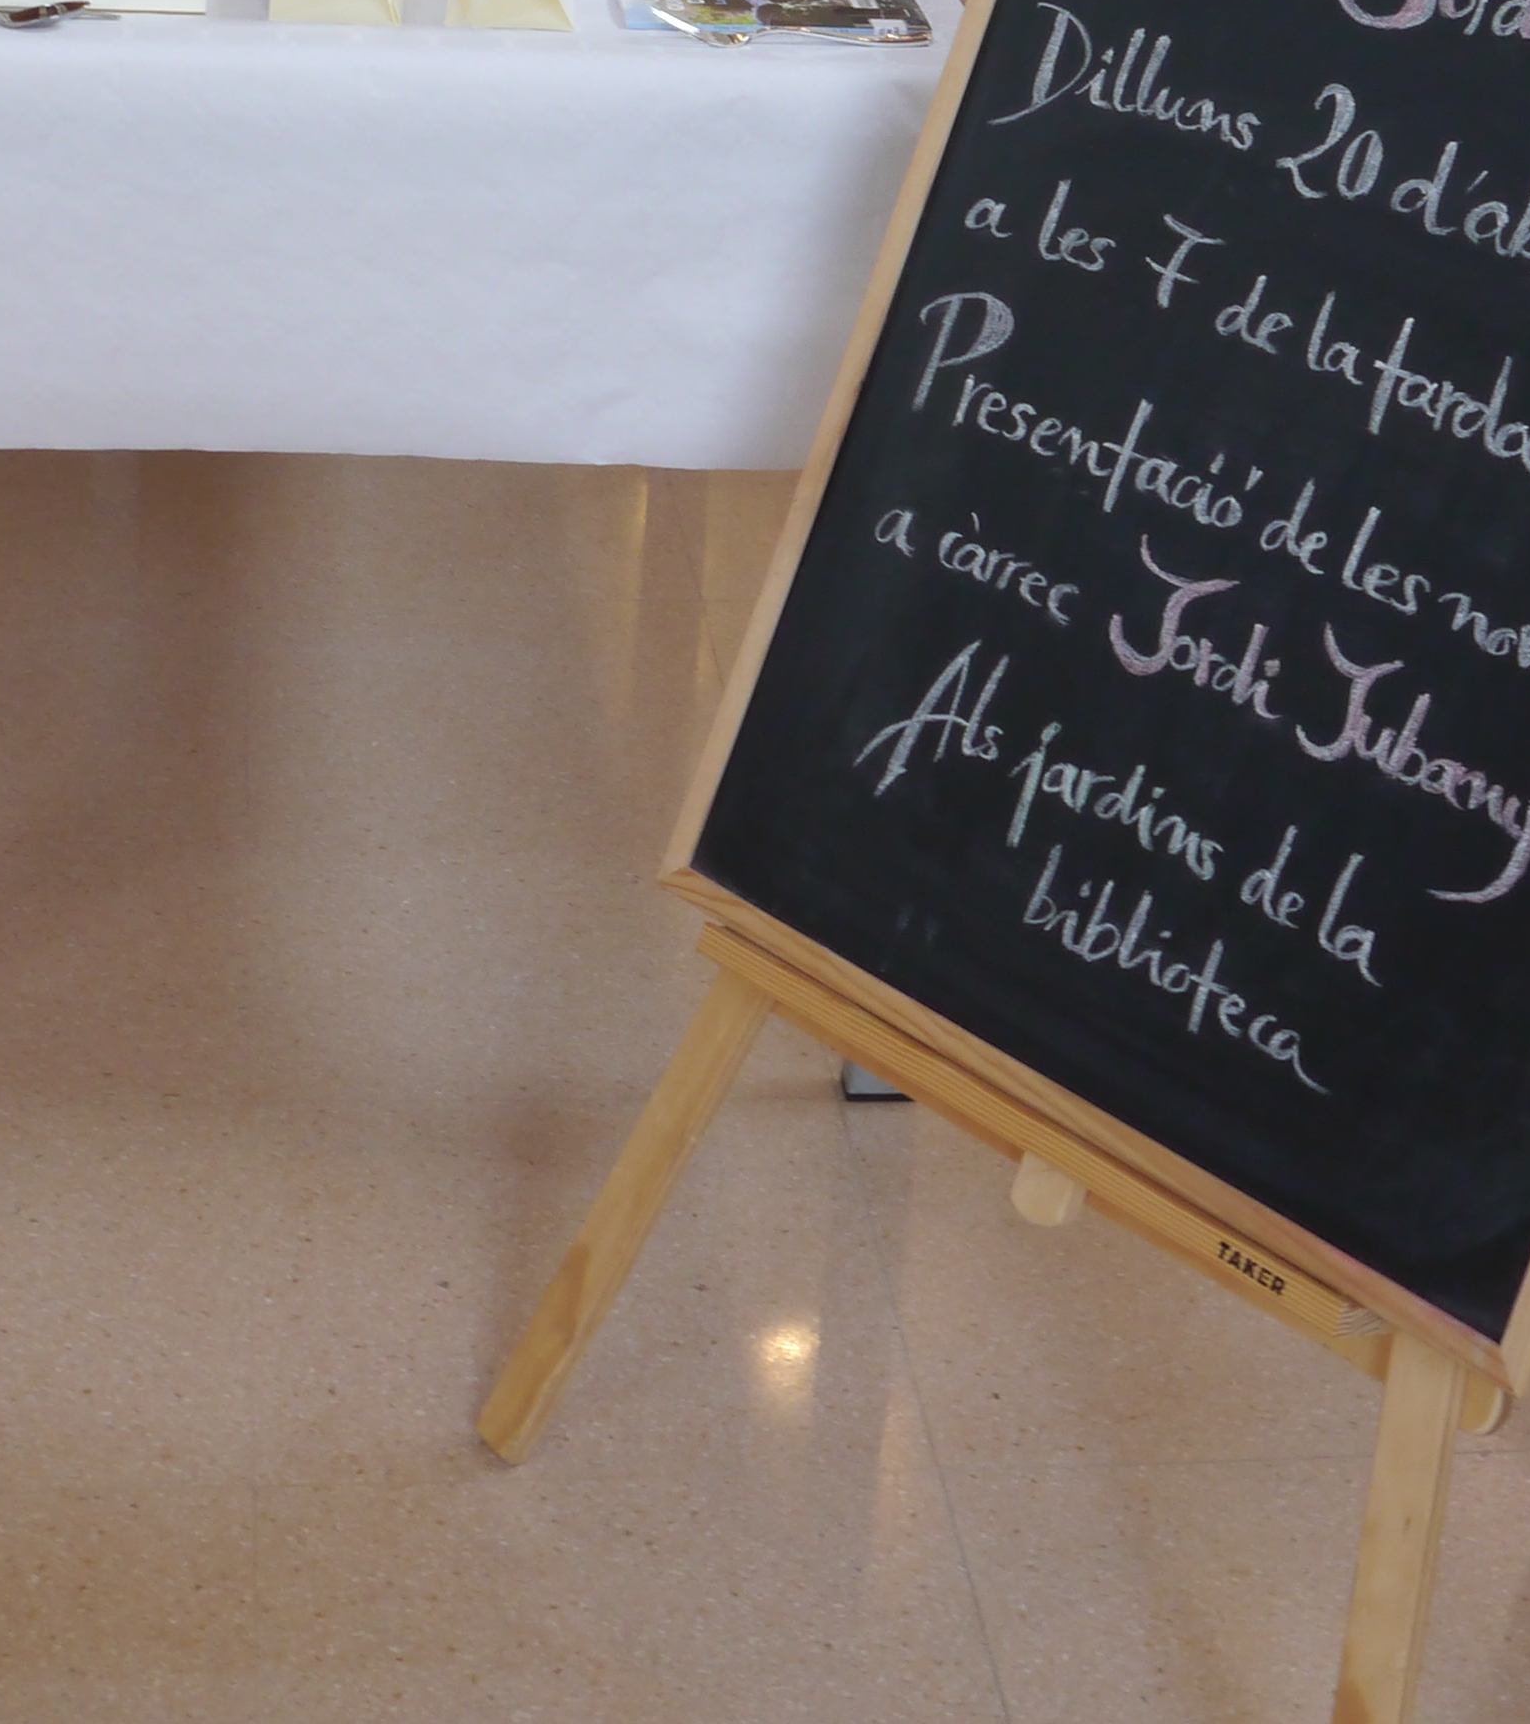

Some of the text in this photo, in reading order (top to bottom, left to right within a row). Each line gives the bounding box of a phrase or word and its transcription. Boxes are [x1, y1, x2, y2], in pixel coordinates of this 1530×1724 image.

[989, 2, 1262, 150] Dilluns
[1276, 83, 1384, 199] 20
[966, 196, 1012, 238] a
[1039, 179, 1116, 272] les
[1145, 214, 1226, 308] 7
[1214, 276, 1293, 355] de
[1307, 291, 1363, 386] la
[913, 291, 1263, 529] Presentació
[1259, 479, 1326, 575] de
[1343, 507, 1430, 615] les
[874, 507, 914, 556] a
[937, 510, 1080, 626] càrrec
[1108, 533, 1283, 719] Jordi
[851, 640, 1383, 987] Als jardins de la
[1022, 844, 1332, 1095] biblioteca
[1217, 1241, 1285, 1295] TAKER
